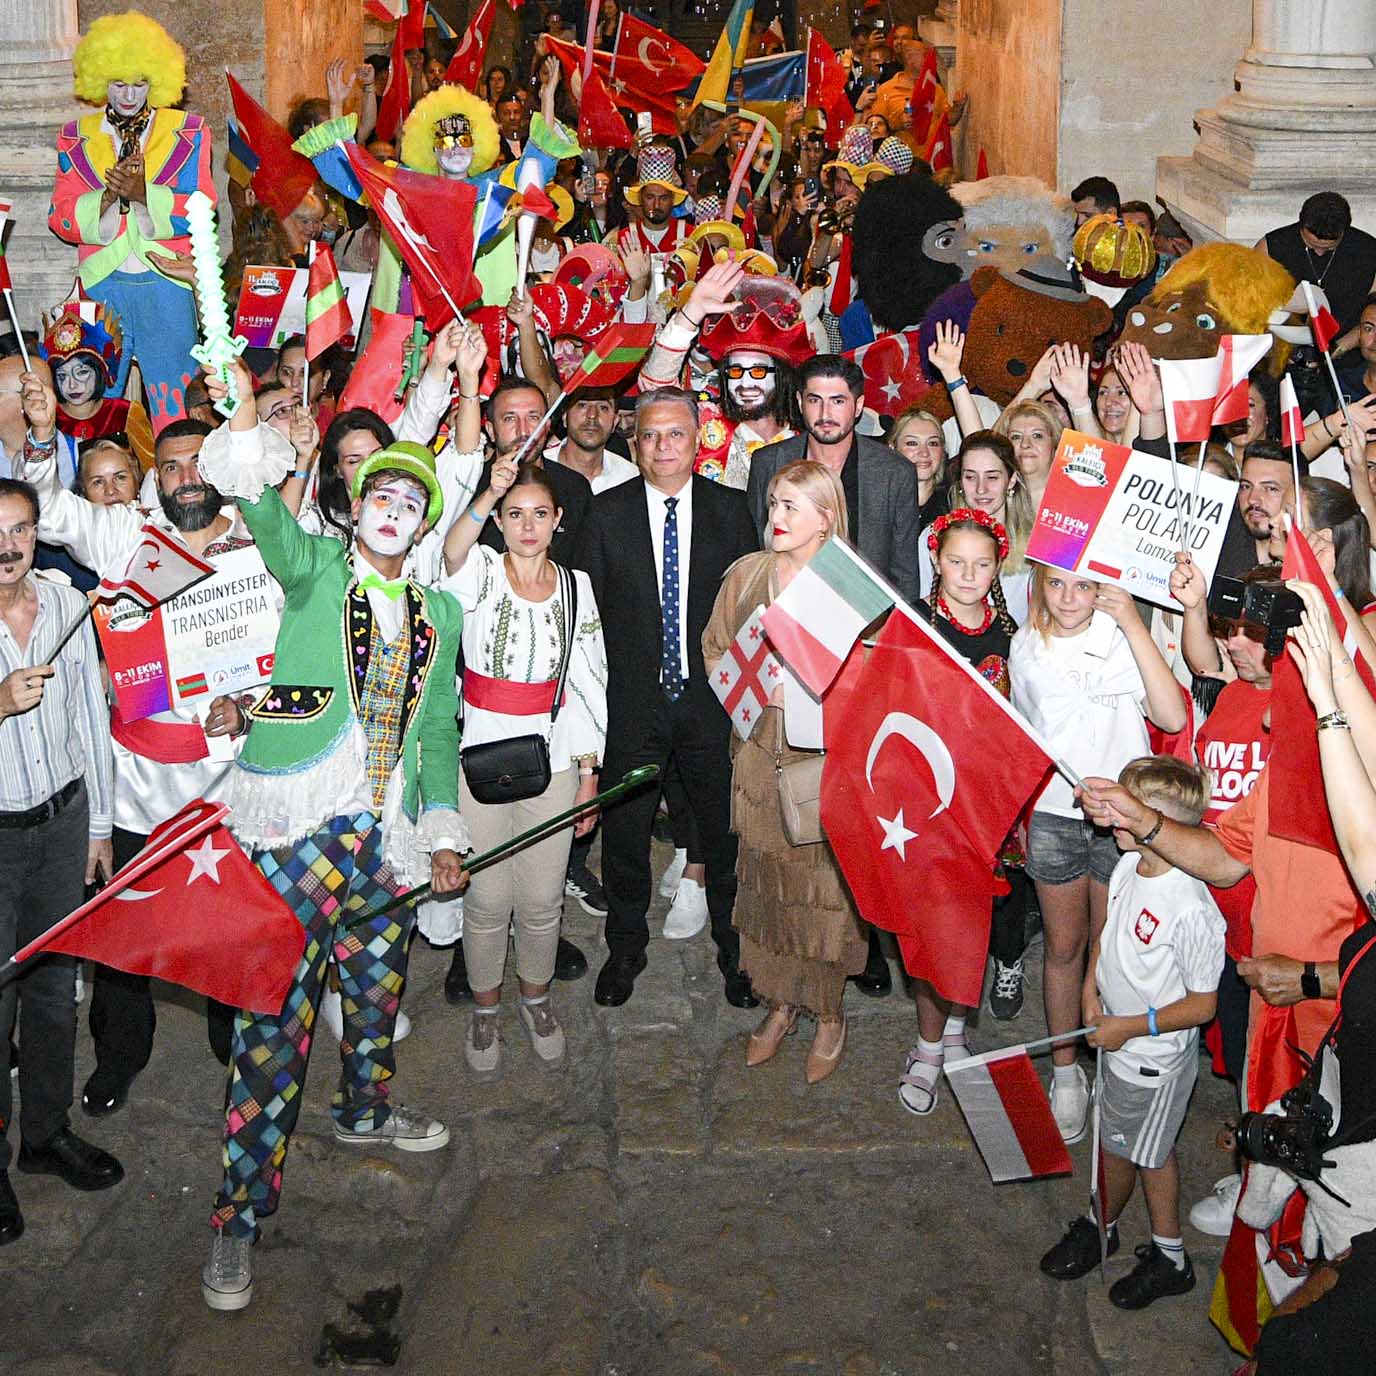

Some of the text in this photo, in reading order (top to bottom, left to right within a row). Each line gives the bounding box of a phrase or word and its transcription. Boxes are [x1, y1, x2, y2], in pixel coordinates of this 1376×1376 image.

[1123, 474, 1223, 525] POLONYA
[1042, 508, 1062, 522] 8-11
[1063, 516, 1089, 532] EKİM
[1122, 503, 1210, 551] POLAND
[1135, 537, 1177, 564] Lomza
[166, 573, 268, 614] TRANSDİNYESTER
[171, 595, 268, 636] TRANSNISTRIA
[205, 624, 249, 648] Bender
[114, 661, 162, 681] 8-11 EKİM
